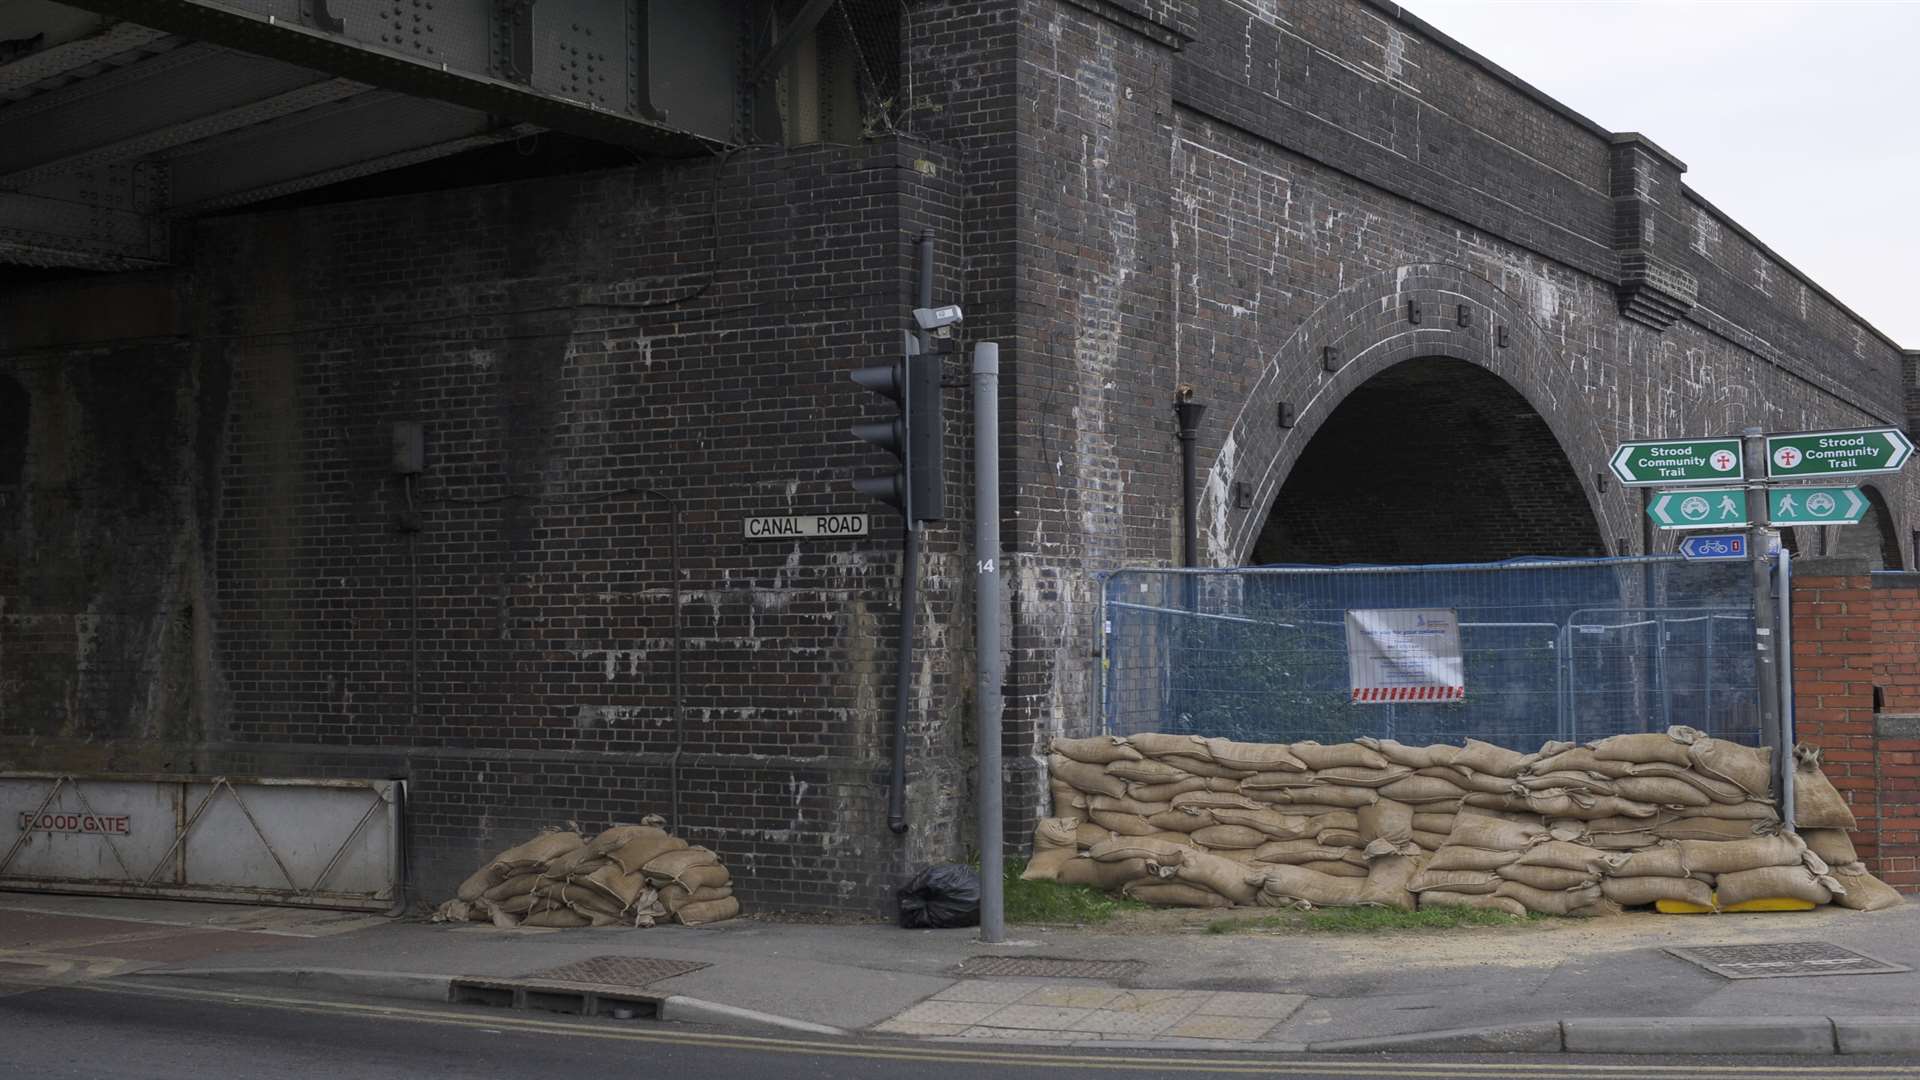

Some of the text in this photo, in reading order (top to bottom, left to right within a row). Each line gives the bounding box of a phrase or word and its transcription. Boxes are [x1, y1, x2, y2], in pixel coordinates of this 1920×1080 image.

[1819, 436, 1864, 448] Strood
[1651, 446, 1692, 456] Strood
[1805, 447, 1880, 459] Community
[1638, 456, 1706, 467] Community
[1828, 458, 1857, 468] Trail
[1659, 467, 1686, 476] Trail
[749, 516, 863, 535] CANAL ROAD
[976, 558, 995, 573] 14
[83, 816, 126, 832] GATE
